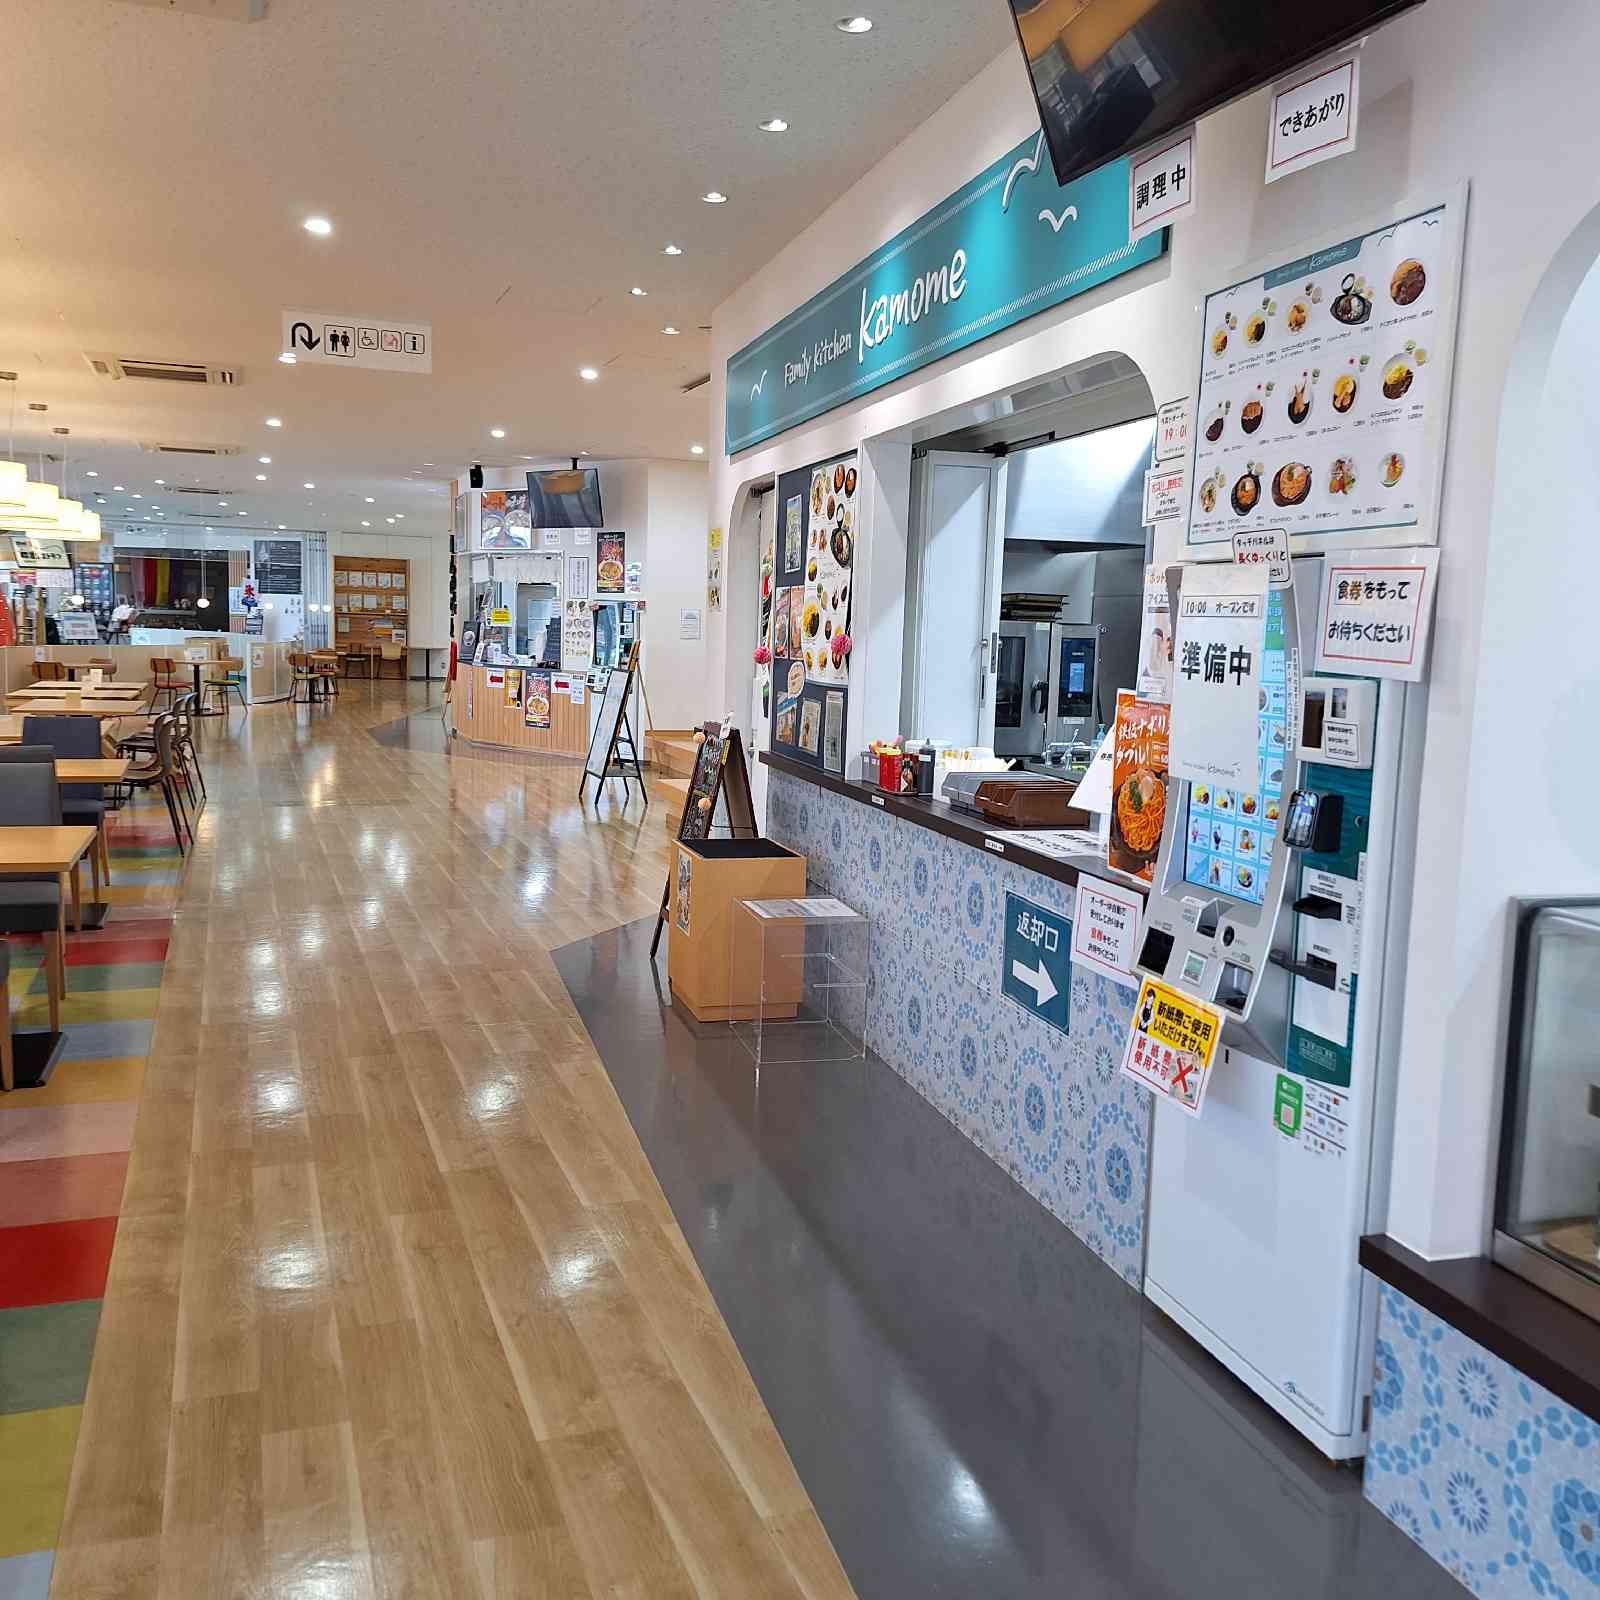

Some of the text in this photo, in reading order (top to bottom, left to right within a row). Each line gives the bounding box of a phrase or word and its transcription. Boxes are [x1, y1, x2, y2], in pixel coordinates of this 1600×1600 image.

[1279, 92, 1345, 137] できあがり
[1136, 164, 1186, 211] 調理中
[784, 347, 812, 389] Family
[858, 248, 967, 365] kamome
[1186, 600, 1256, 614] 10:00 オープンです
[1337, 580, 1411, 600] 食券をもって
[1328, 620, 1411, 643] お待ちください
[1180, 641, 1252, 686] 準備中
[1119, 714, 1170, 739] 鉄板ナポリ
[1016, 911, 1059, 952] 返却口
[1158, 1001, 1212, 1041] 新紙幣ご使用
[1135, 1050, 1169, 1081] 使用不可
